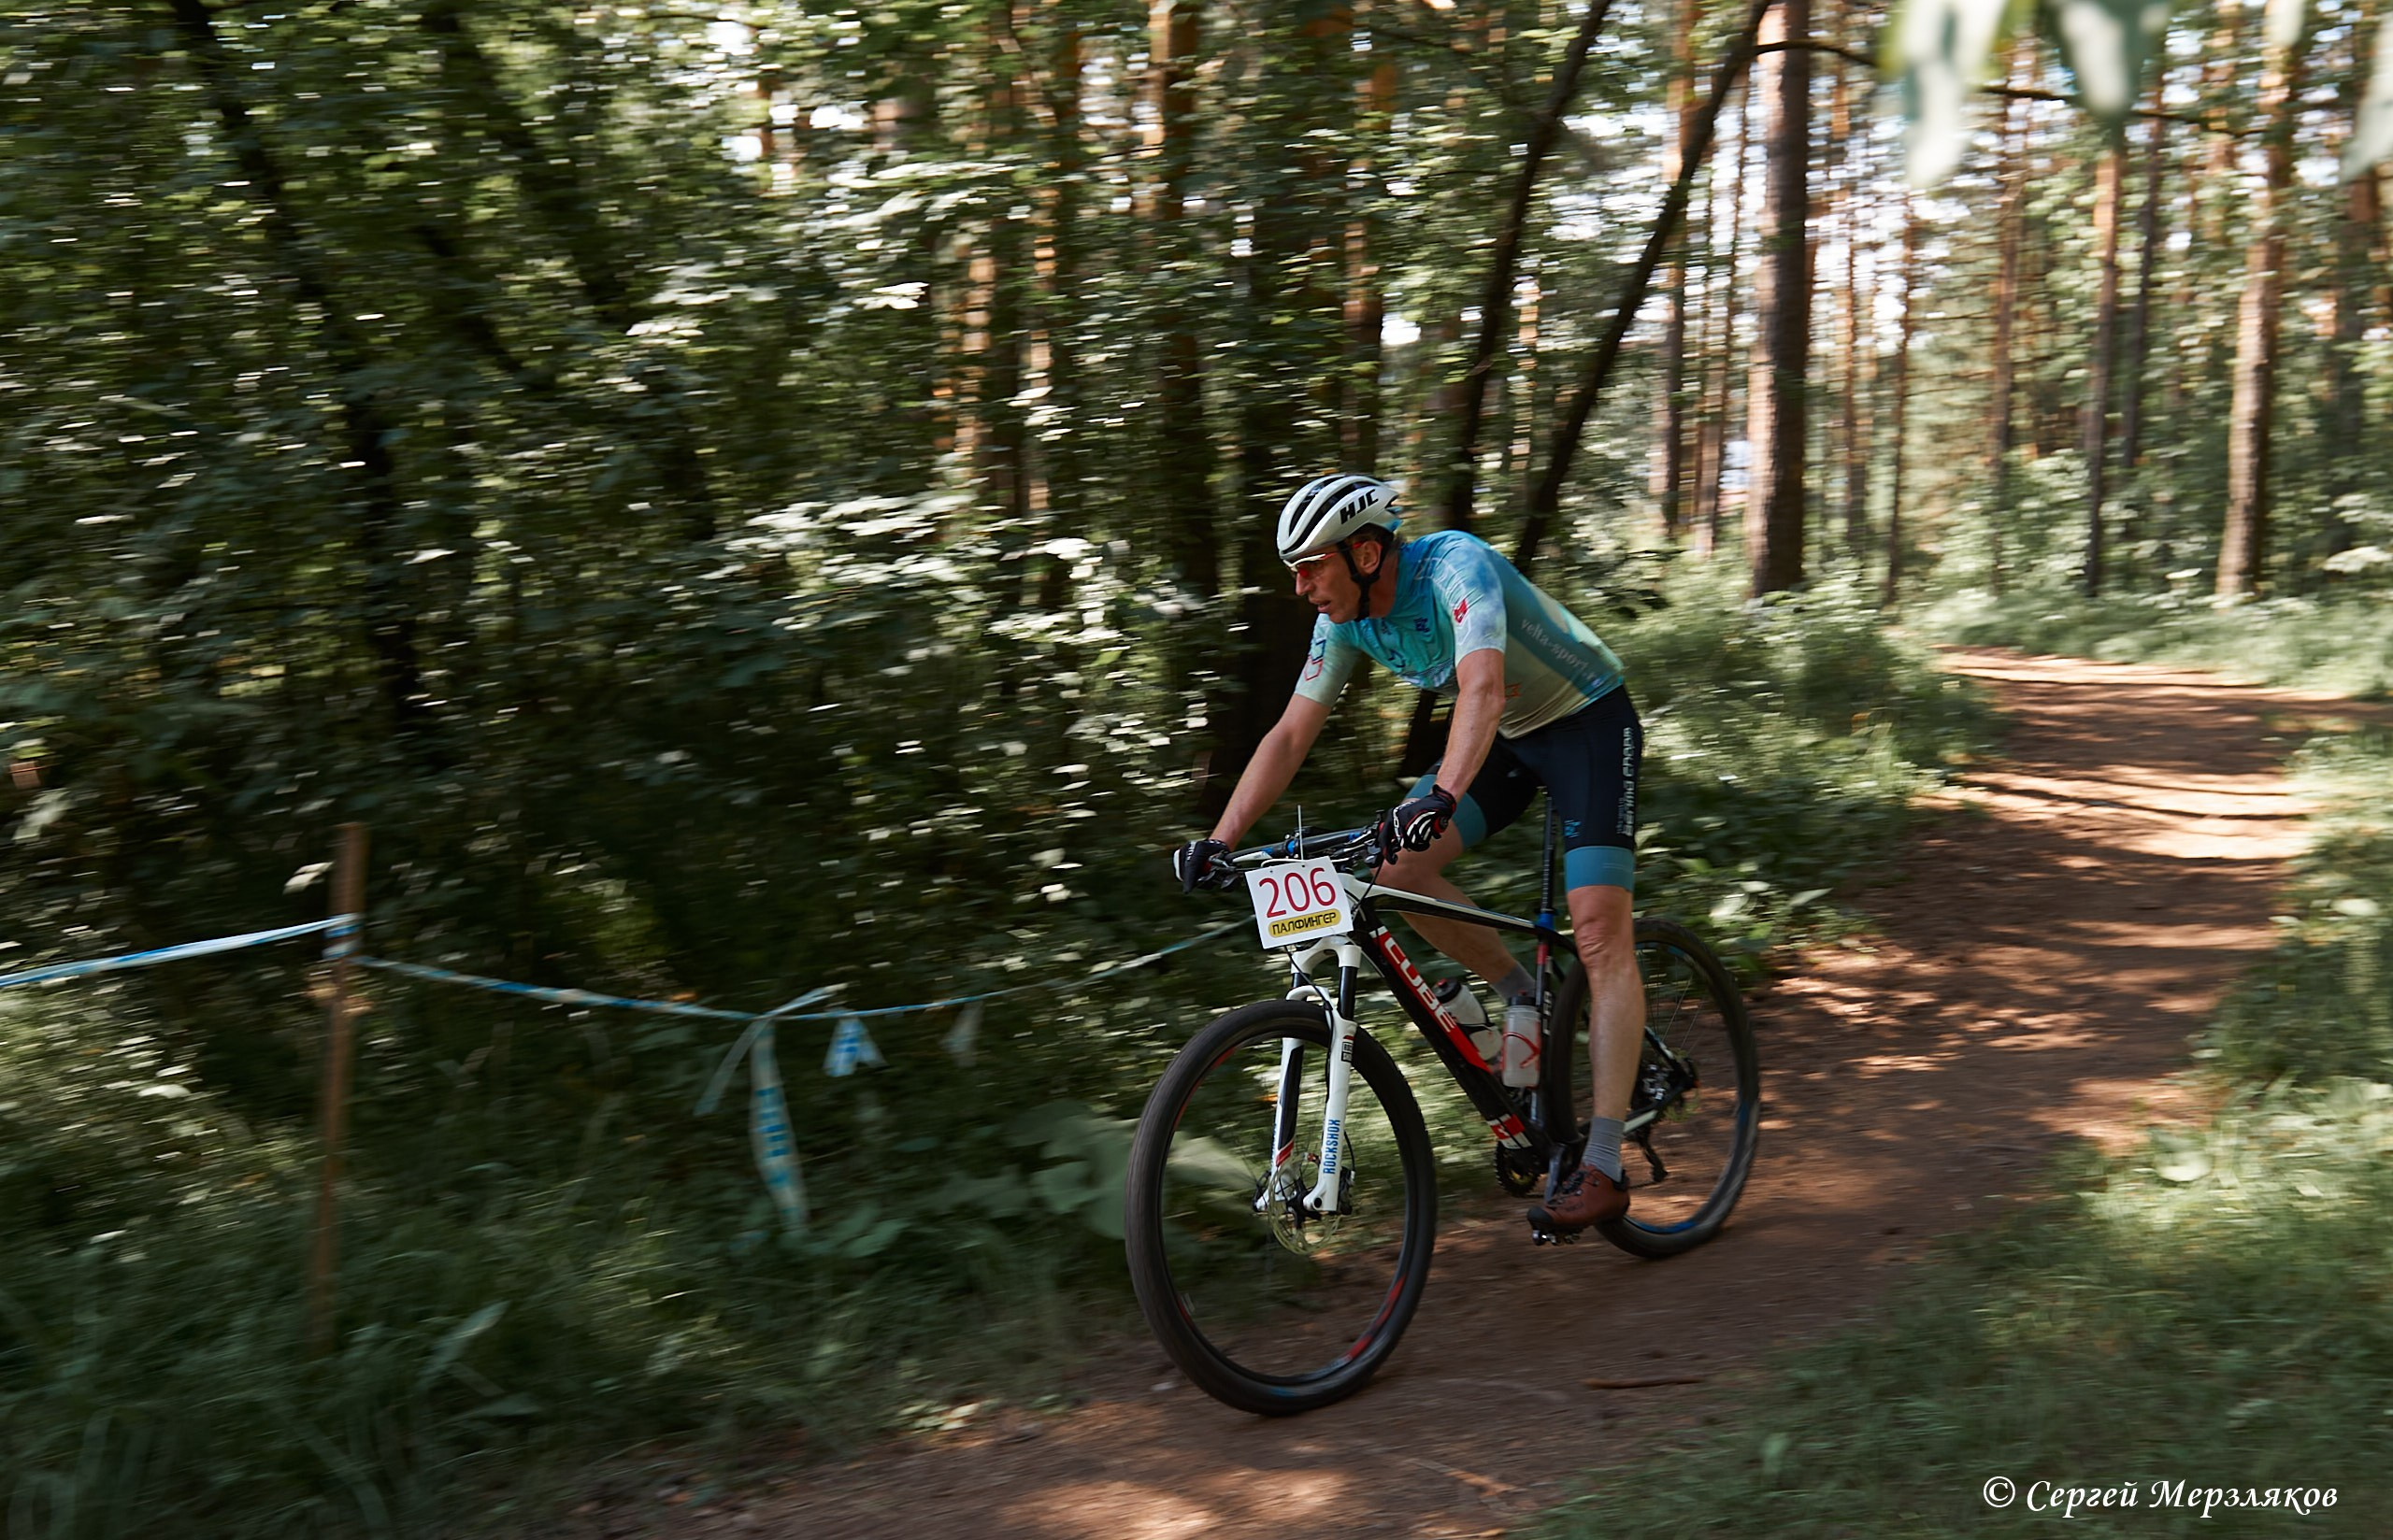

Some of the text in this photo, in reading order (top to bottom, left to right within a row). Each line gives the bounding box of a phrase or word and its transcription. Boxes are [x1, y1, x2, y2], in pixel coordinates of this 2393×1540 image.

[1340, 489, 1379, 524] HJC
[1258, 867, 1337, 918] 206
[1272, 912, 1337, 935] ПАЛФИНГЕР
[1384, 937, 1456, 1033] CUBE
[1323, 1119, 1341, 1175] ROCKSHOX
